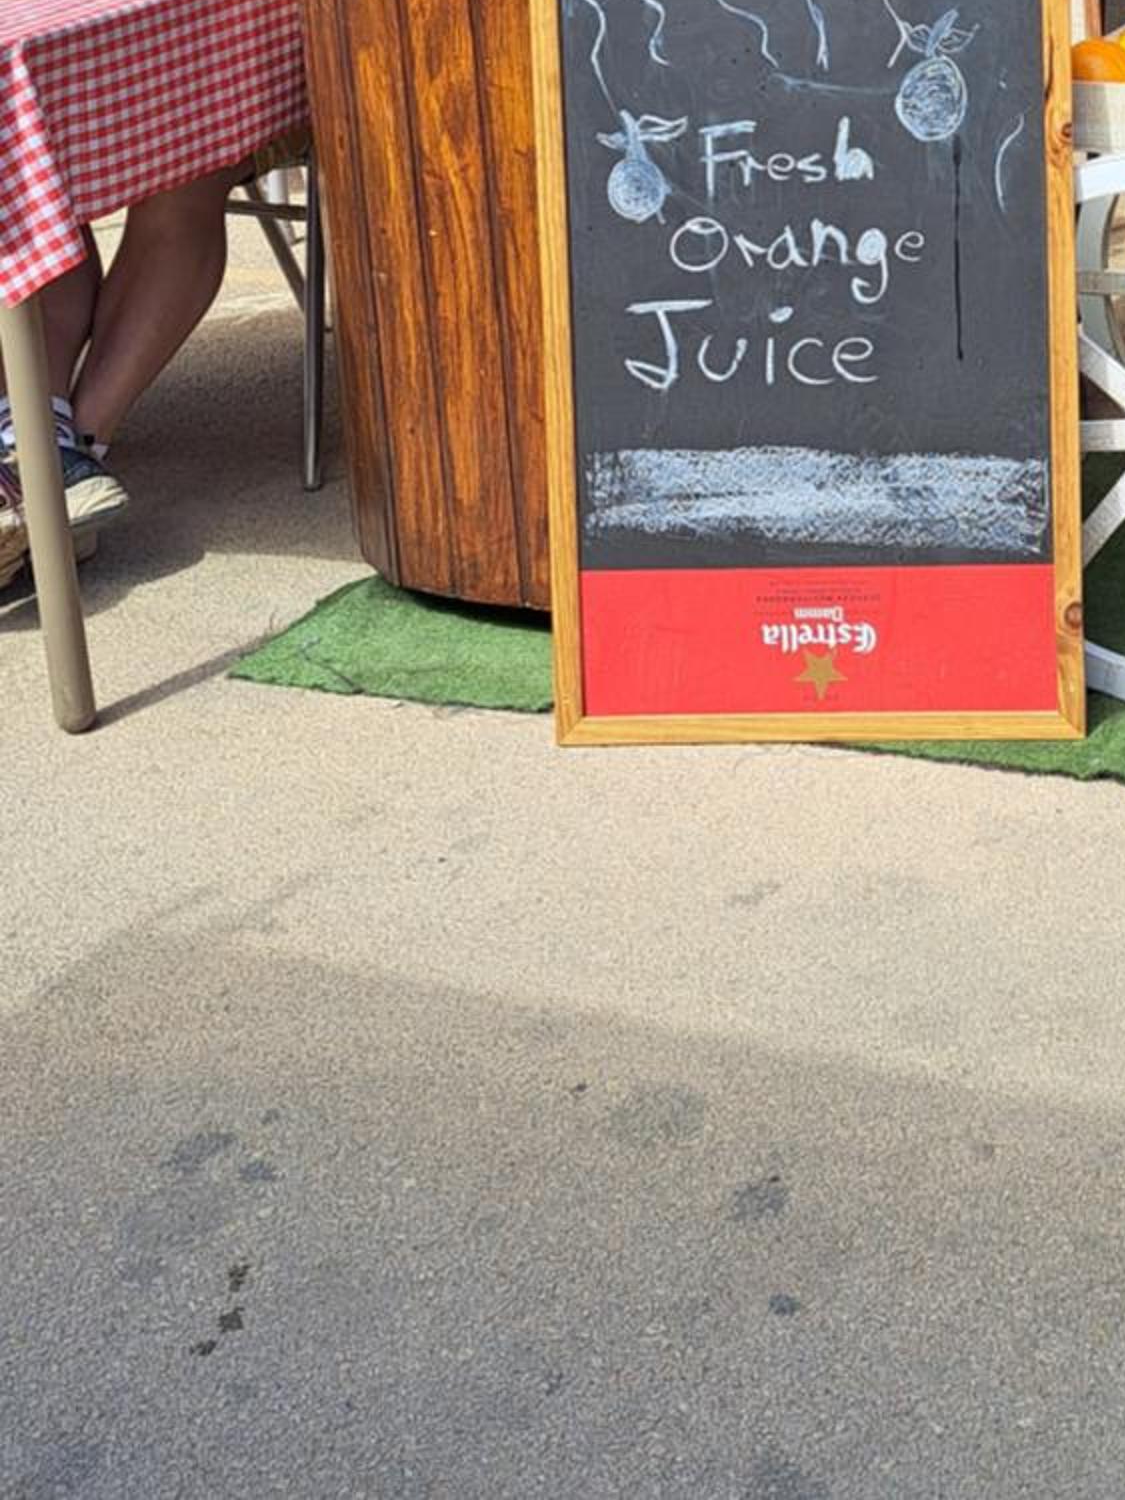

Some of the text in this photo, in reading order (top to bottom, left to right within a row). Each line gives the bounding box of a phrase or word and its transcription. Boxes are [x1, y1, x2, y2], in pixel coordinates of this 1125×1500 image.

[698, 116, 875, 198] Fresh
[669, 217, 926, 304] Orange
[624, 299, 880, 390] Juice
[761, 621, 877, 654] Estrella
[792, 605, 843, 621] Damm
